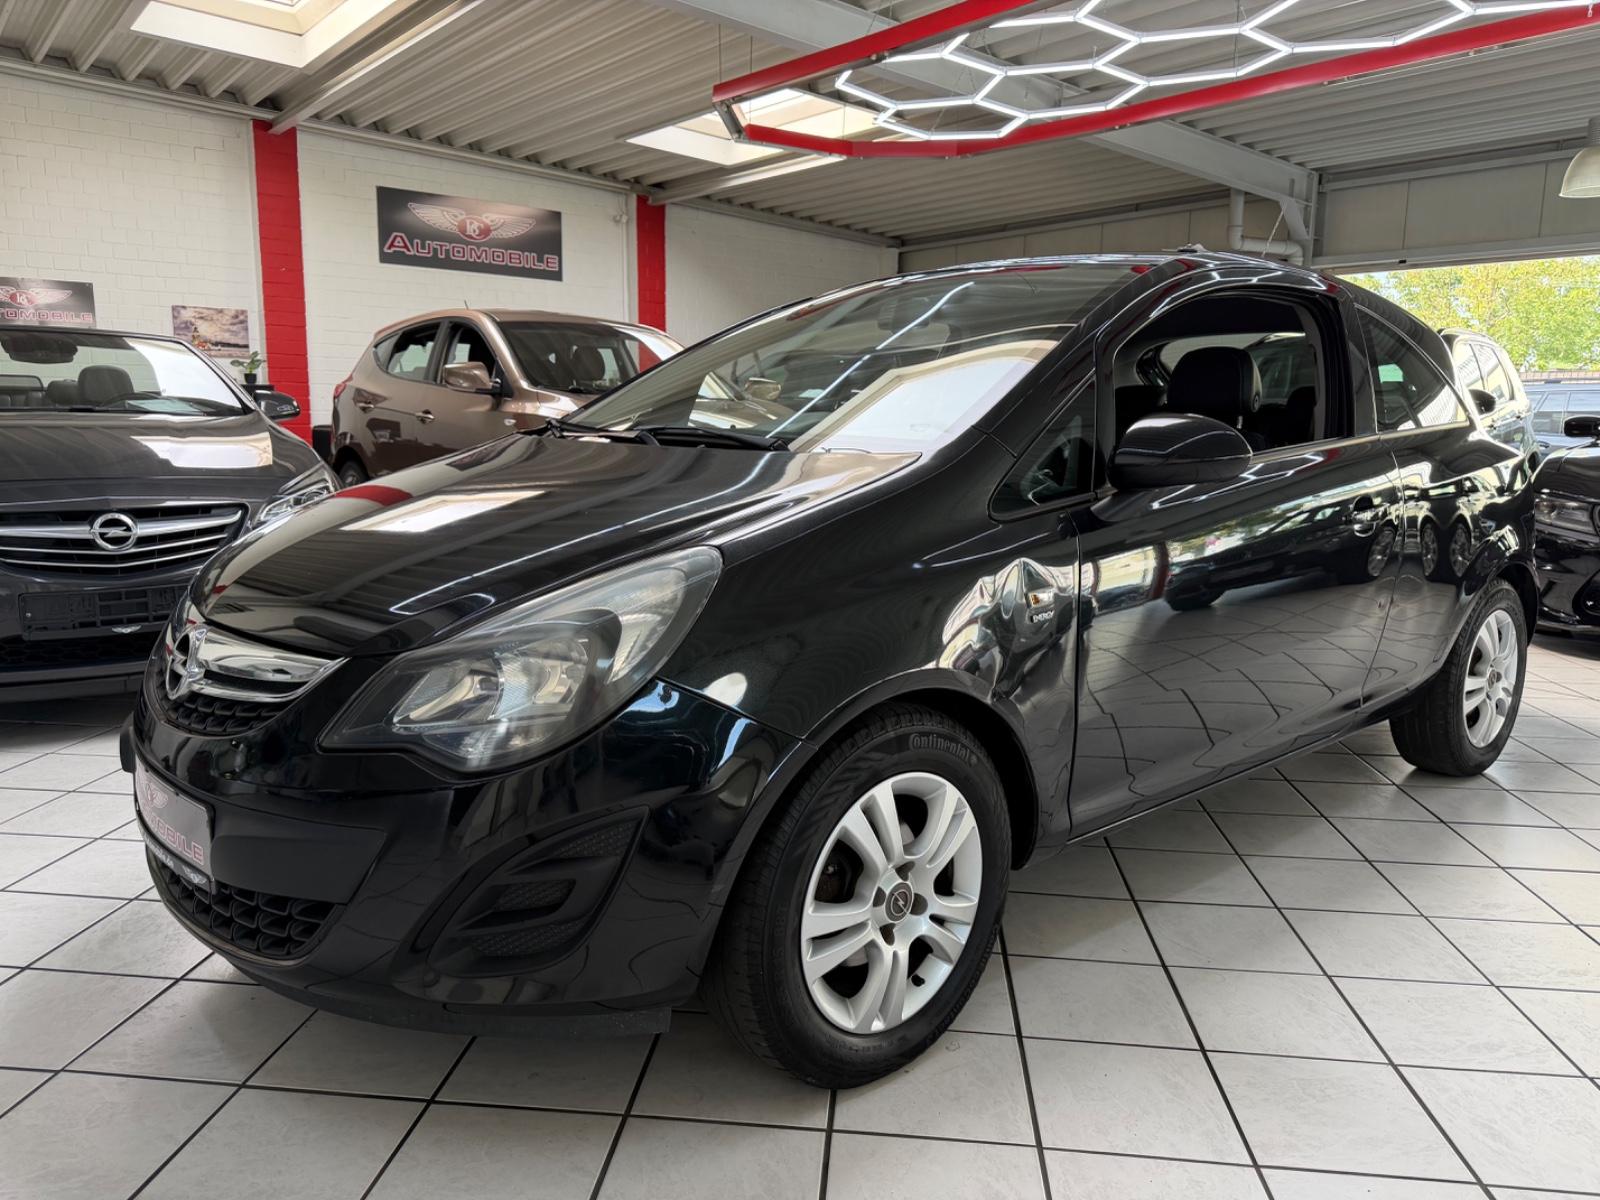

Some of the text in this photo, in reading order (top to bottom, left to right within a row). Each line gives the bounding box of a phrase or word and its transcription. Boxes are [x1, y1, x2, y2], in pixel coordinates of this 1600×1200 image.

[384, 232, 560, 271] AUTOMOBILE
[0, 308, 93, 323] OMOBILE
[909, 733, 970, 762] Continental
